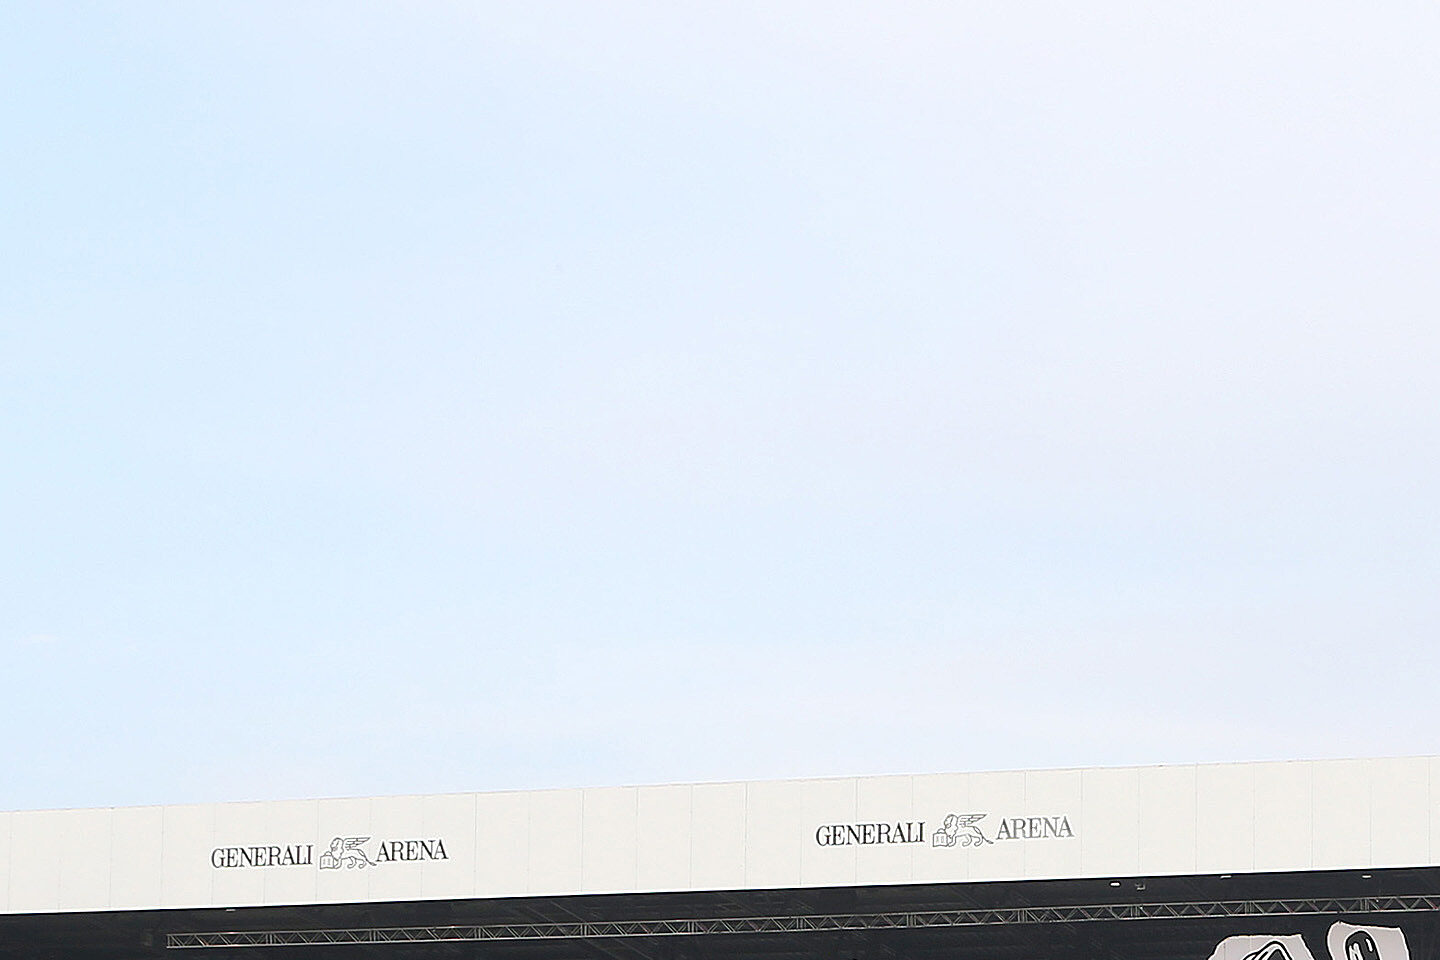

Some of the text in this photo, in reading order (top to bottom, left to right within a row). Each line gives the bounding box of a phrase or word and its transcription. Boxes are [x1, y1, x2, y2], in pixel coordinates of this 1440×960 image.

[816, 818, 1071, 846] GENERALI ARENA
[212, 840, 448, 868] GENERALI ARENA
